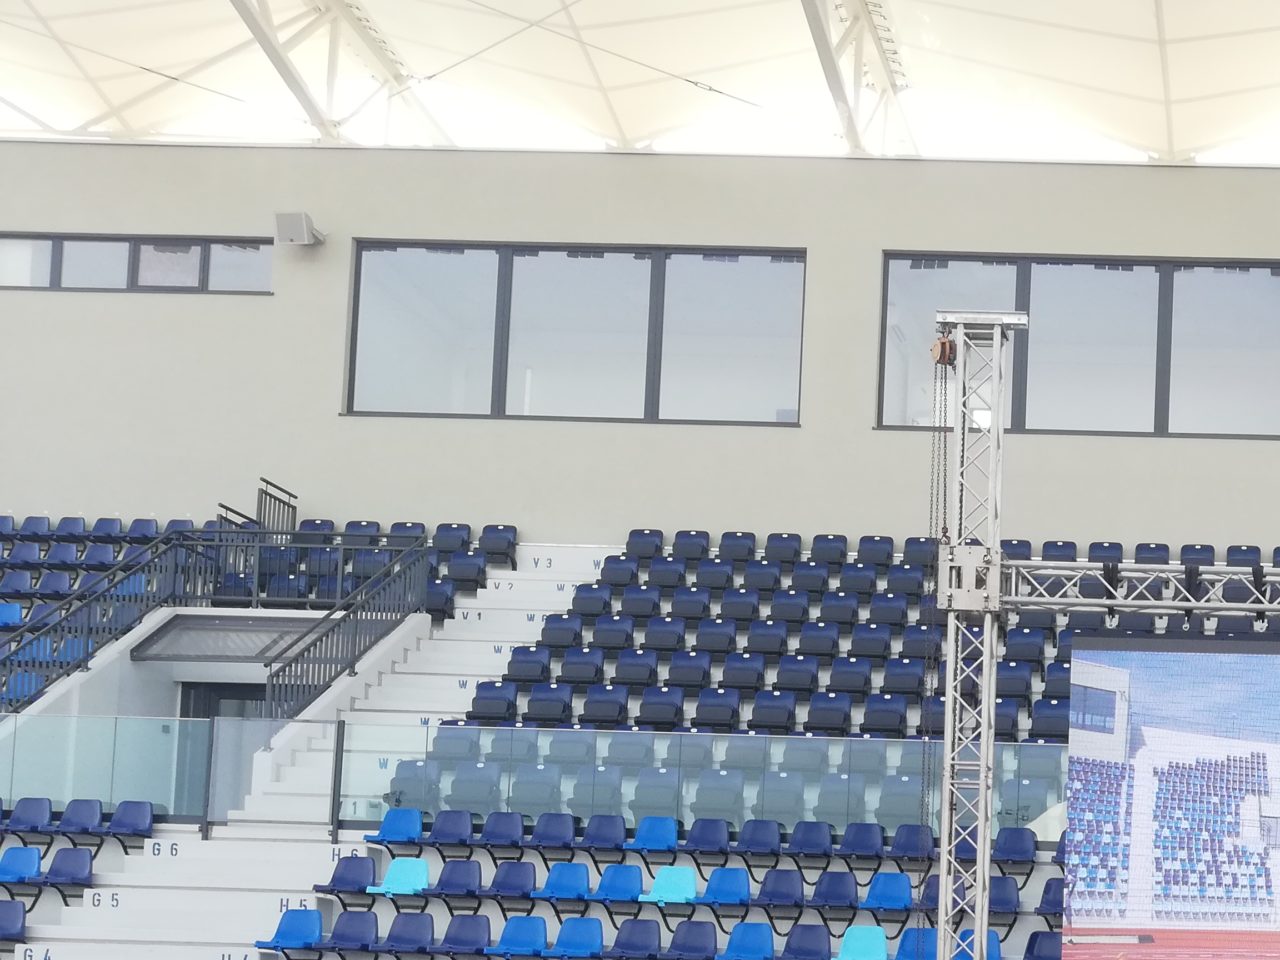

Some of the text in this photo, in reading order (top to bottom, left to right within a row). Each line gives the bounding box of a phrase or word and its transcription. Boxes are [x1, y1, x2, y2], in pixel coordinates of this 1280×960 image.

[533, 557, 552, 569] V 3
[494, 582, 501, 590] V
[557, 583, 565, 591] W
[462, 611, 482, 621] V 1
[526, 613, 535, 622] W
[493, 646, 502, 654] W
[458, 679, 467, 689] W
[420, 717, 429, 725] W
[378, 758, 389, 769] W
[152, 842, 179, 857] G 6
[332, 847, 341, 862] H
[92, 892, 119, 908] G 5
[280, 898, 289, 913] H
